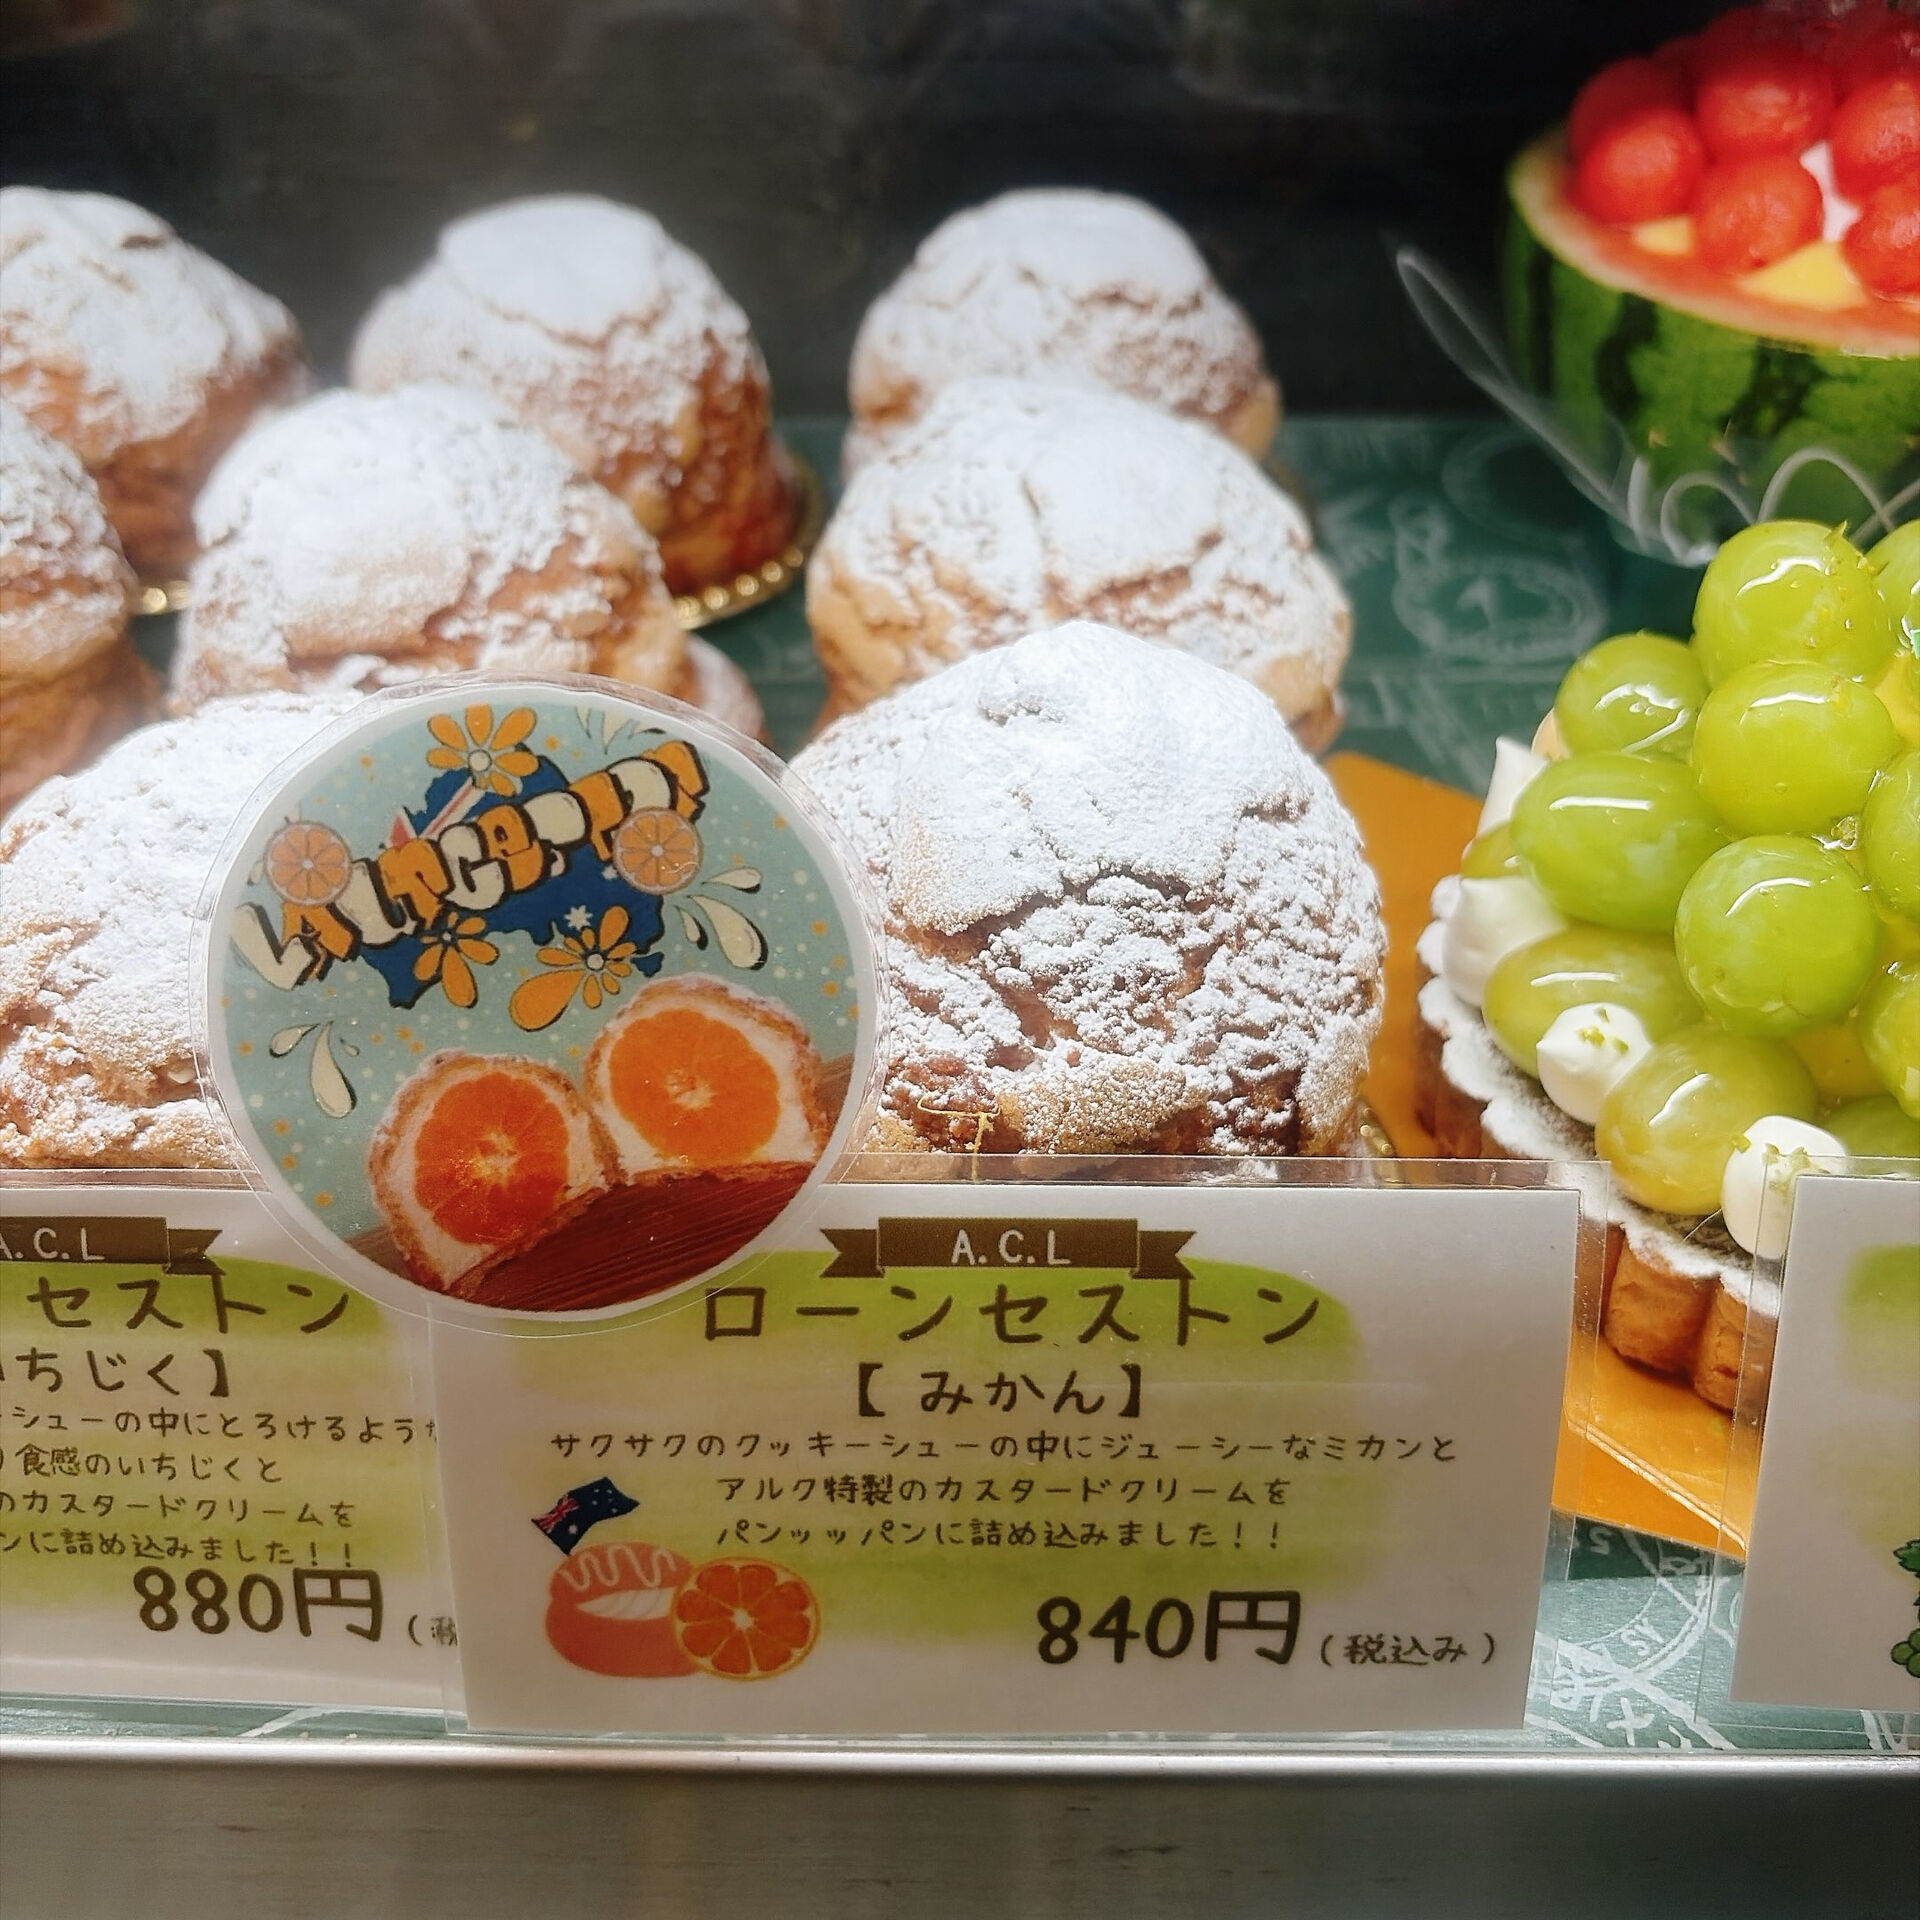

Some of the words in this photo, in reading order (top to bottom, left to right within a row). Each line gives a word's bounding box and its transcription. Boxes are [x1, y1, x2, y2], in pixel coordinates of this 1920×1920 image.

[951, 1229, 1071, 1266] A.C.L
[27, 1275, 348, 1334] セストン
[705, 1278, 1319, 1347] ローンセストン
[0, 1347, 230, 1398] ちじく】
[0, 1407, 437, 1445] シューの中にとろけるよう
[717, 1474, 1291, 1507] アルク特製のカスタードクリームを
[133, 1565, 384, 1642] 880円
[1036, 1589, 1302, 1665] 840円
